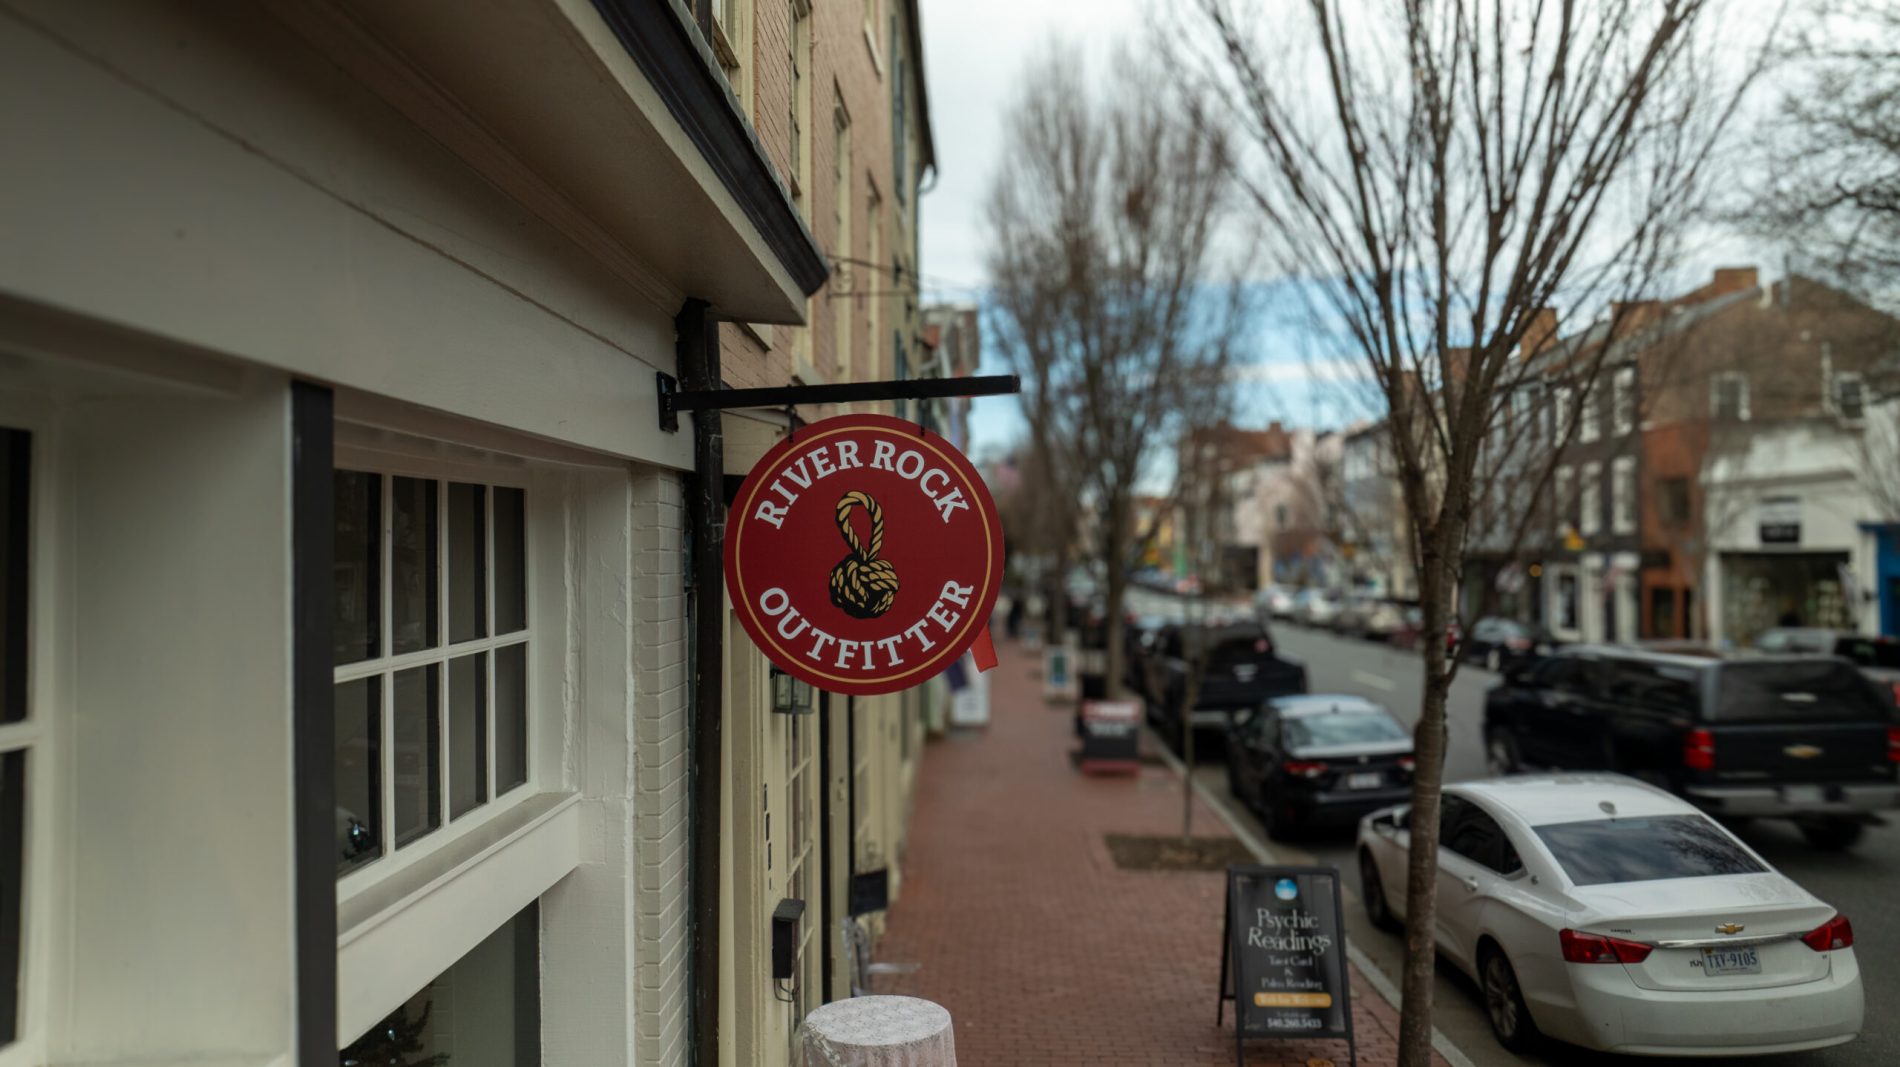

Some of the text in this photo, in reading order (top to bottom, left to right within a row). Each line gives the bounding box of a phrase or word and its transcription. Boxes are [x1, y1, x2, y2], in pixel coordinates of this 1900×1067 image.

[754, 439, 970, 529] RIVER ROCK
[759, 579, 974, 670] OUTFITTER
[1248, 927, 1331, 955] Readings
[1256, 908, 1318, 935] Psychic
